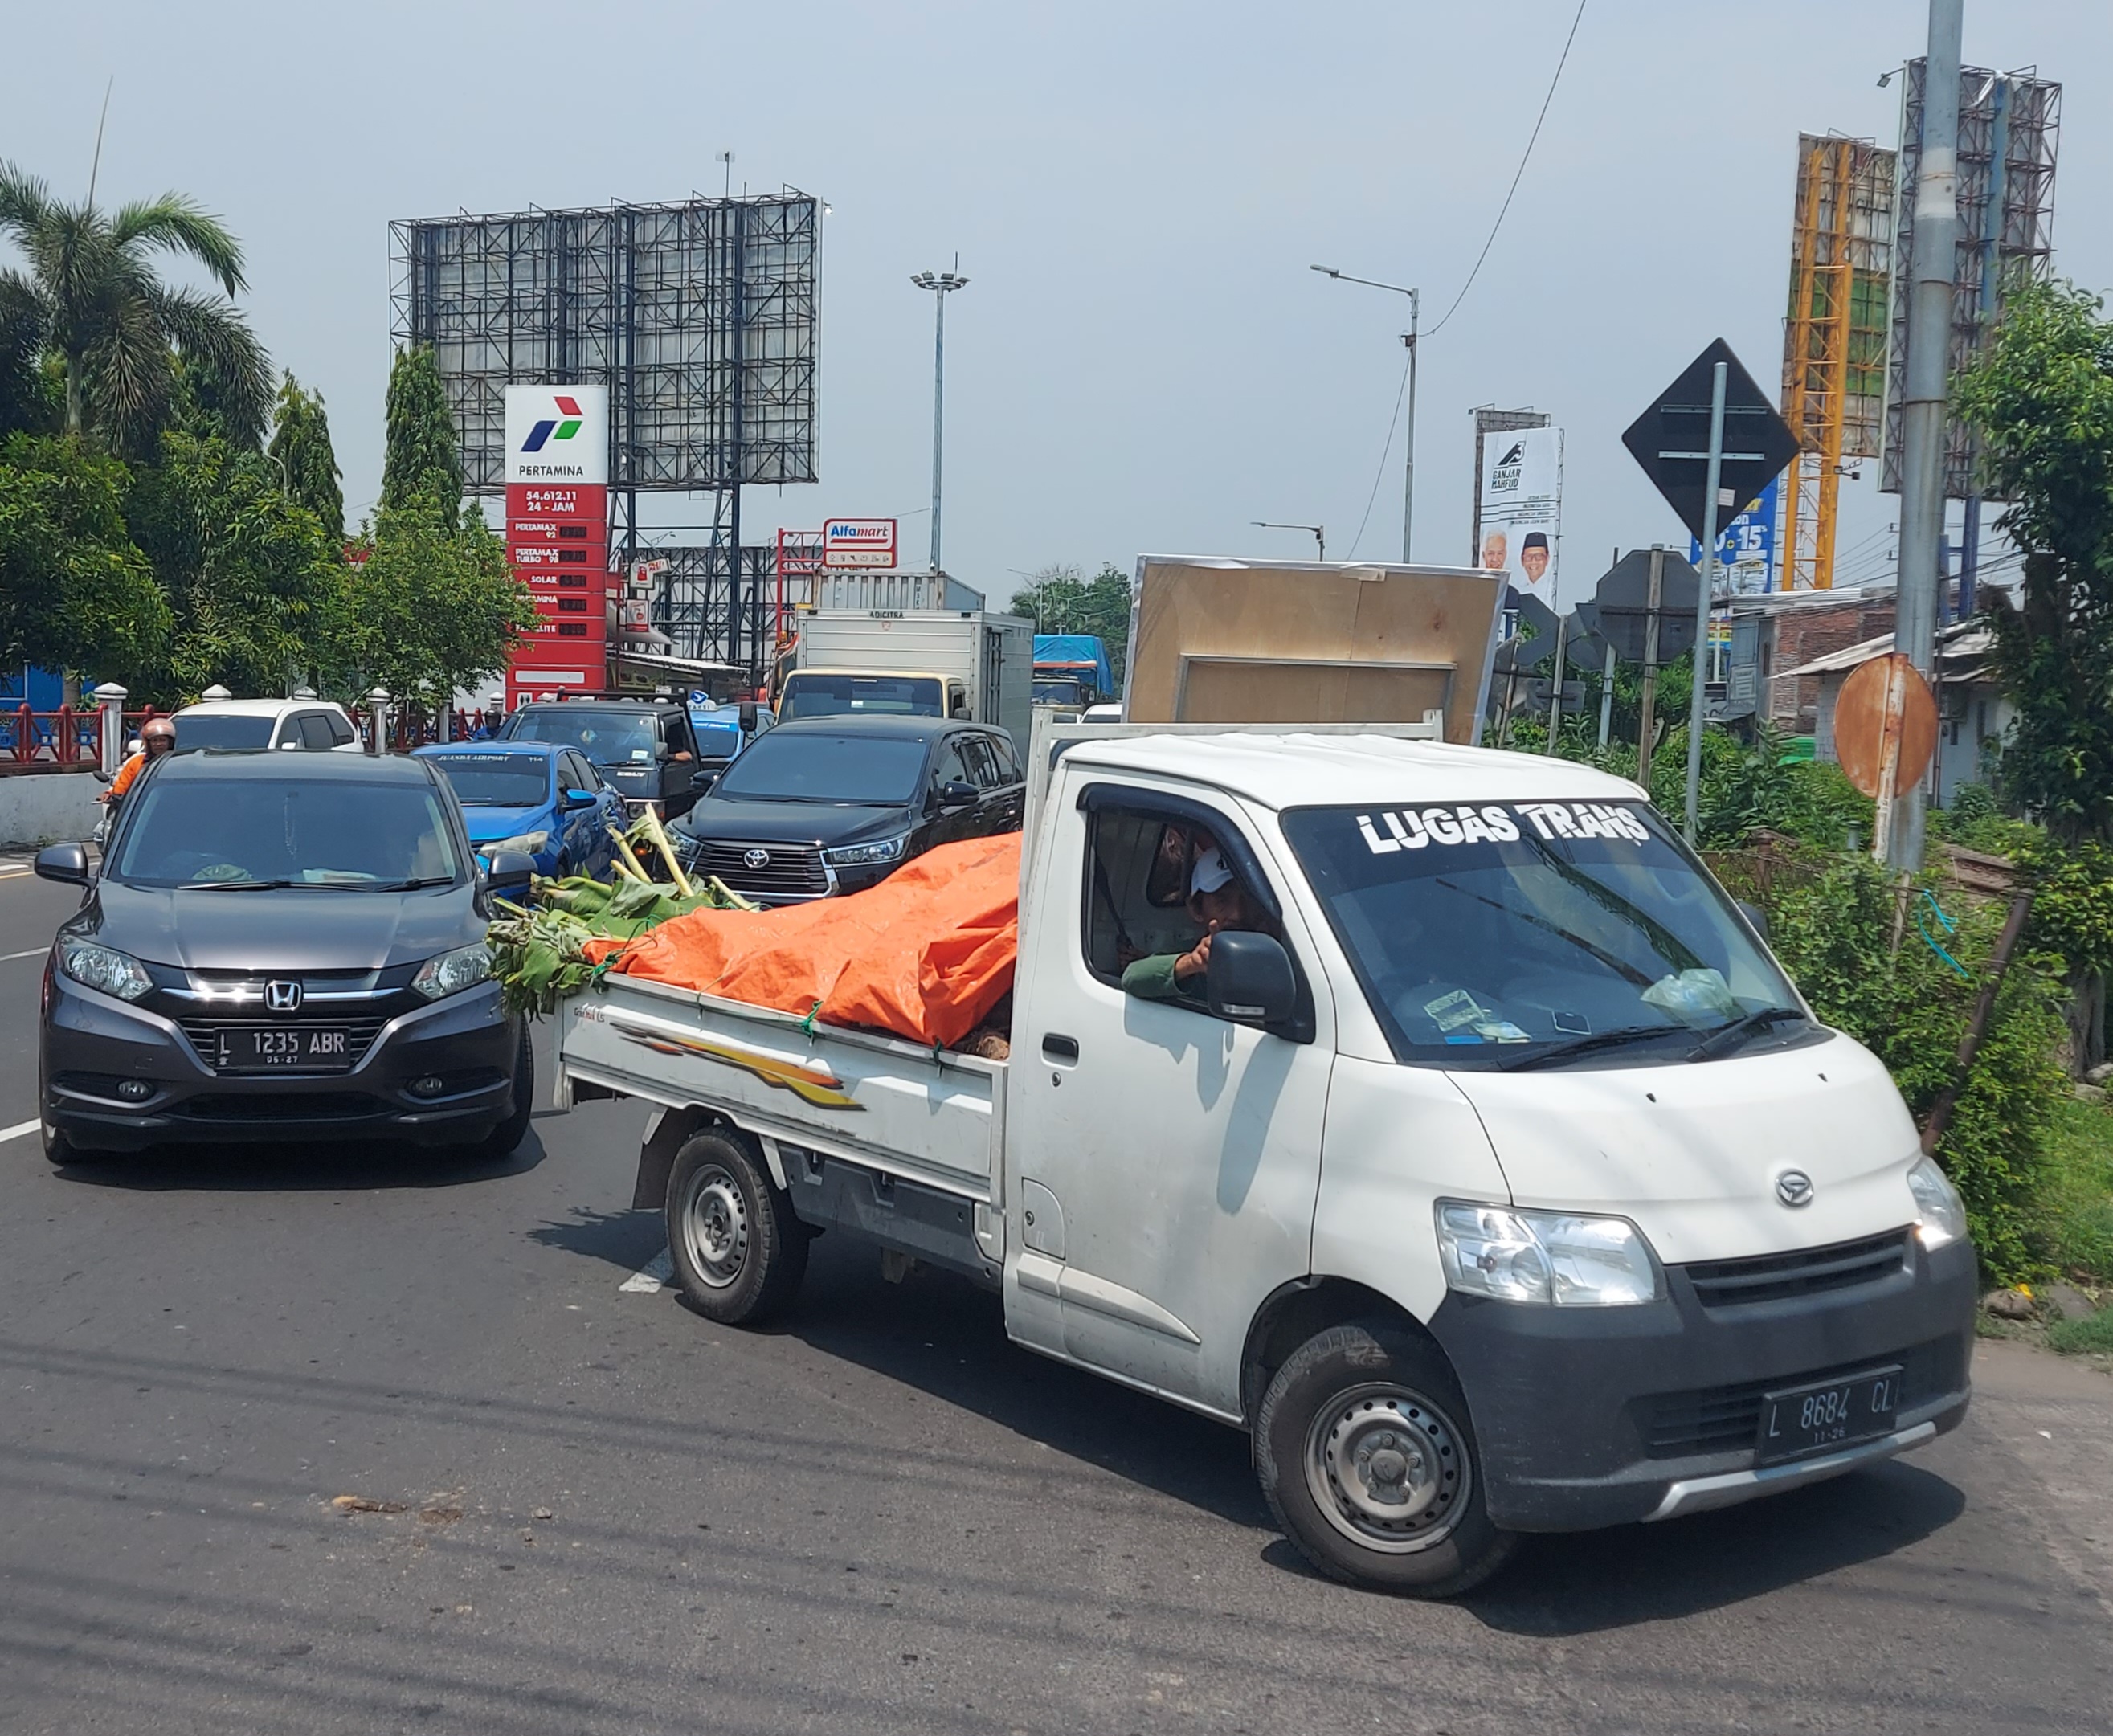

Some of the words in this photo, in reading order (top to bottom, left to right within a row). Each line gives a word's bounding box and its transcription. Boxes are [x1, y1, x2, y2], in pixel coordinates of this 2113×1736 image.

[519, 465, 584, 476] PERTAMINA
[1492, 468, 1522, 480] GANJAR
[525, 490, 577, 501] 54.612.11
[527, 502, 542, 512] 24
[551, 502, 575, 513] JAM
[515, 523, 557, 531] PERTAMAX
[830, 525, 889, 537] Alfamart
[515, 548, 559, 556] PERTAMAX
[516, 555, 542, 563] TURBO
[530, 576, 558, 584] SOLAR
[869, 611, 905, 619] ADICITRA
[1355, 805, 1521, 855] LUGAS
[1514, 803, 1650, 848] TRANS
[219, 1033, 231, 1055] L
[253, 1032, 299, 1054] 1235
[309, 1032, 345, 1054] ABR
[1769, 1404, 1780, 1438] L
[1800, 1387, 1851, 1429] 8684
[1871, 1379, 1892, 1413] CL
